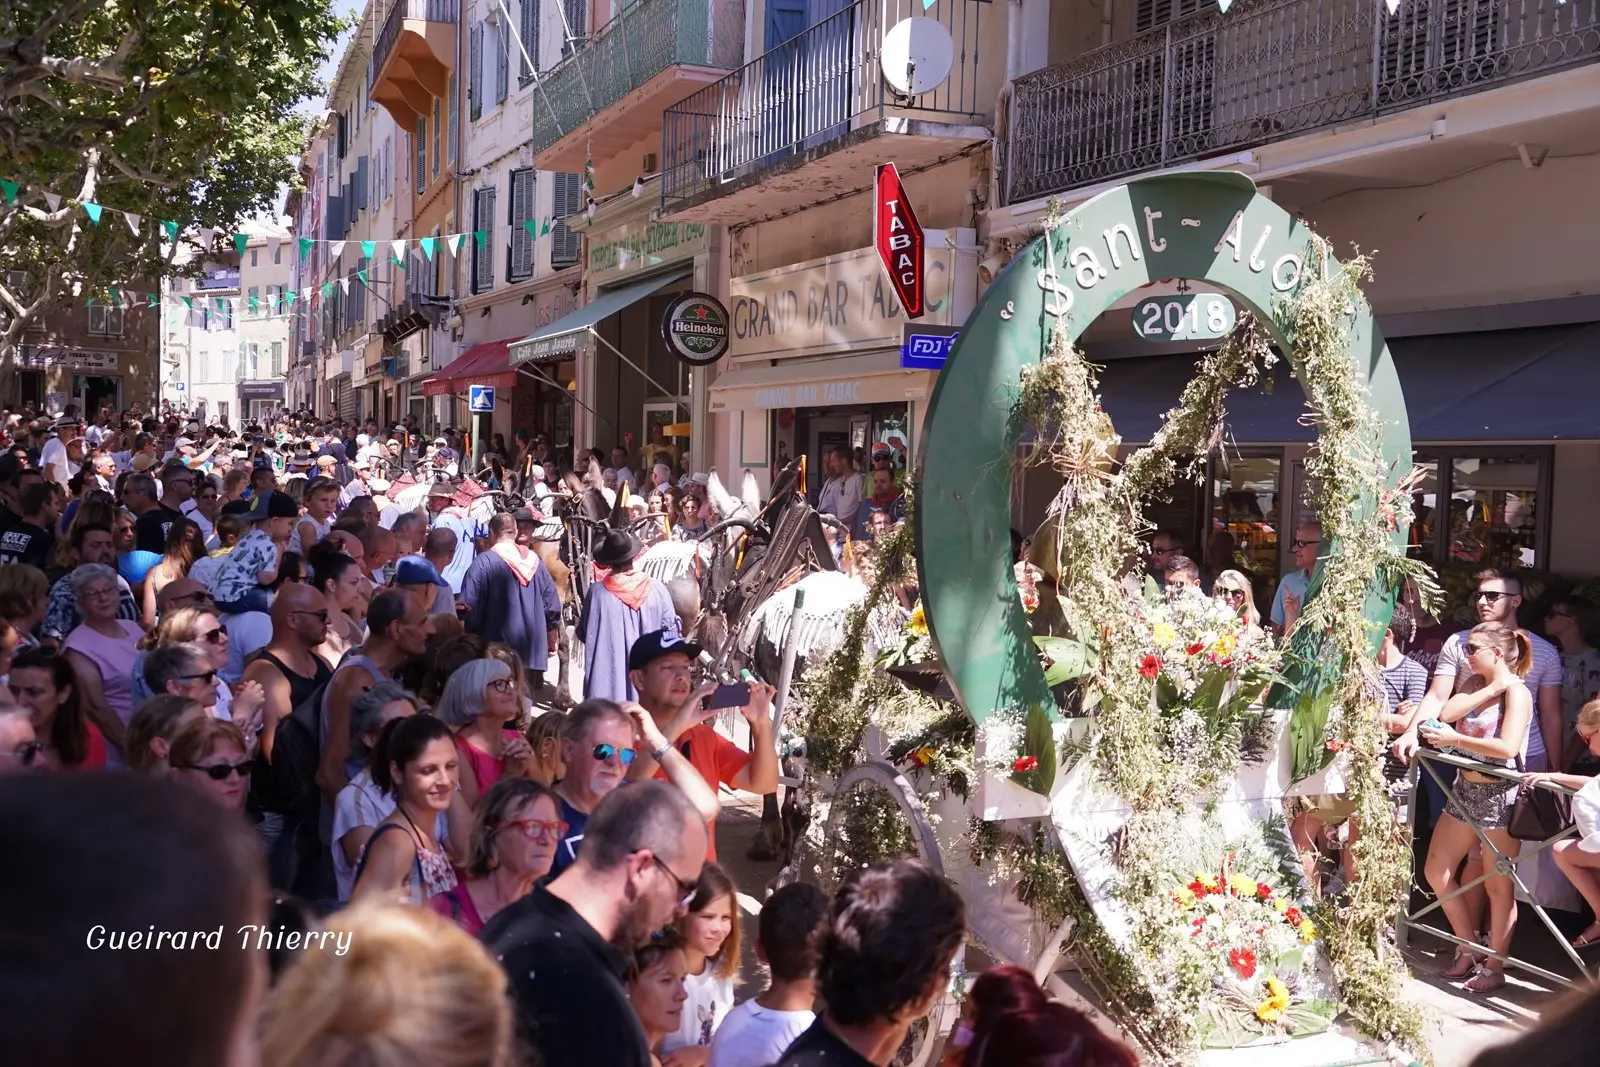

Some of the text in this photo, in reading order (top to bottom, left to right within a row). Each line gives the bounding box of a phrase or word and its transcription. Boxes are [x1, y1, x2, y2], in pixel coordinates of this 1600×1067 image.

[886, 200, 915, 286] TABAC
[734, 260, 945, 339] GRAND BAR TAC
[675, 321, 724, 335] Heineken
[1141, 301, 1228, 333] 2018
[533, 342, 549, 356] Jean
[913, 339, 943, 354] FDJ
[756, 380, 861, 407] GRAND BAR TABAC
